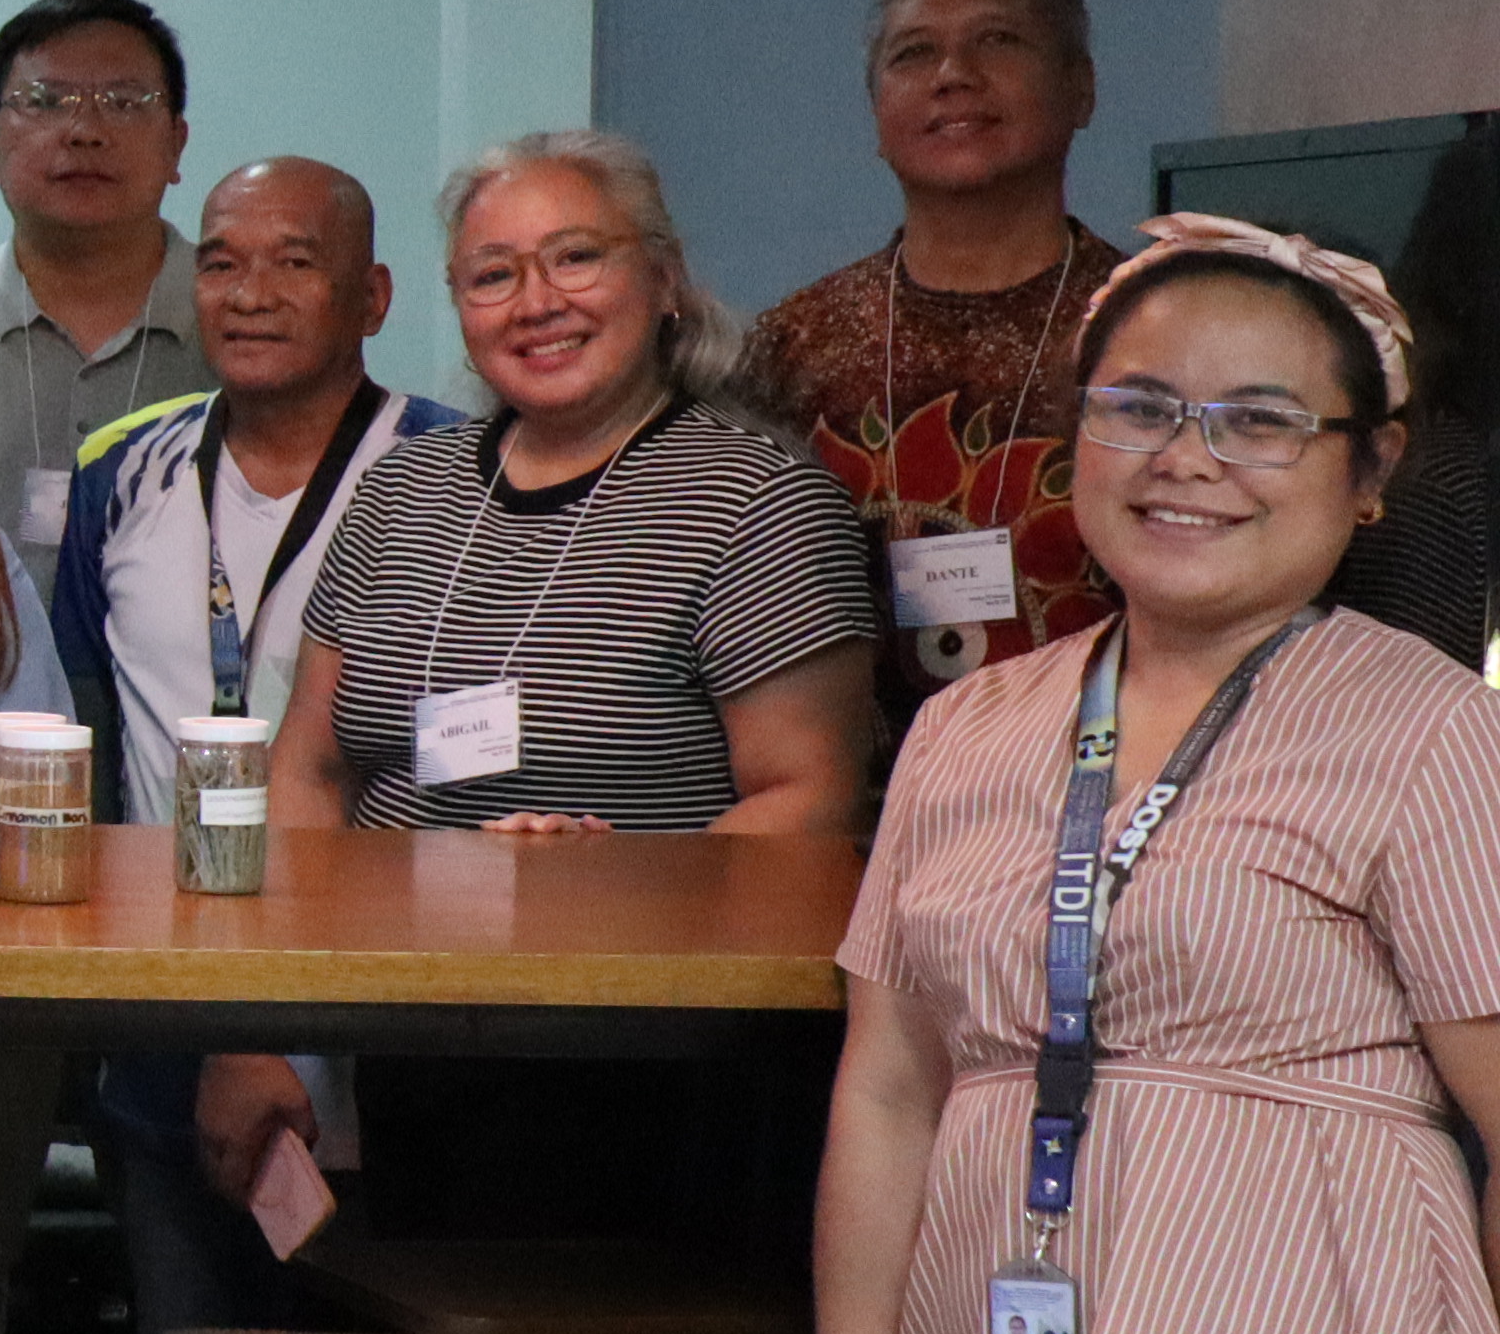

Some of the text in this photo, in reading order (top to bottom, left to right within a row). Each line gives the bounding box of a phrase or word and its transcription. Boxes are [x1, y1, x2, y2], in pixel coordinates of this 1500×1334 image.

[926, 567, 979, 582] DANTE
[440, 720, 492, 739] ABIGAIL
[1110, 783, 1178, 870] DOST
[1052, 853, 1096, 922] ITDI
